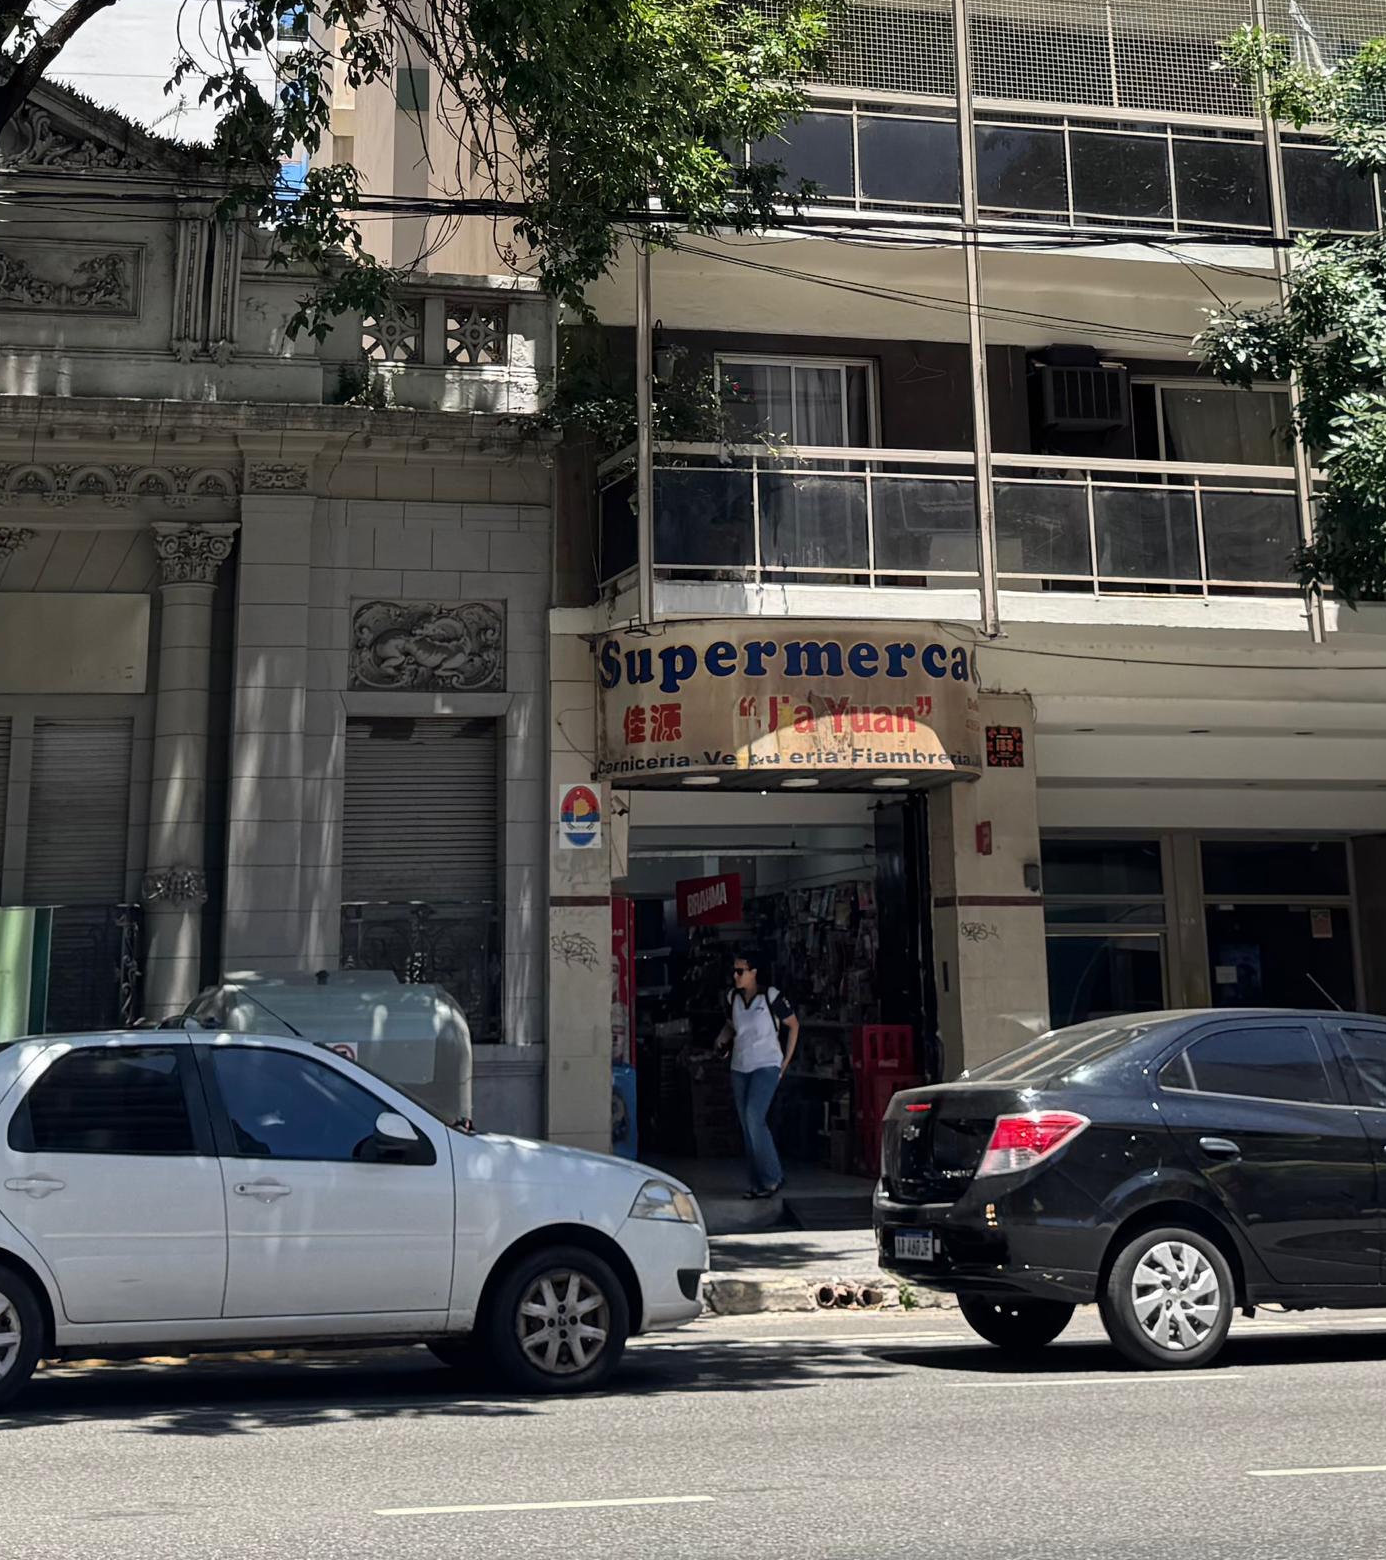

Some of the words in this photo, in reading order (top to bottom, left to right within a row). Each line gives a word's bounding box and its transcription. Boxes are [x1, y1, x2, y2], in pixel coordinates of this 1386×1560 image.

[600, 640, 977, 693] Supermerca
[598, 753, 690, 774] Carniceria
[851, 748, 971, 766] Fiambreria
[687, 882, 728, 917] BRAHMA
